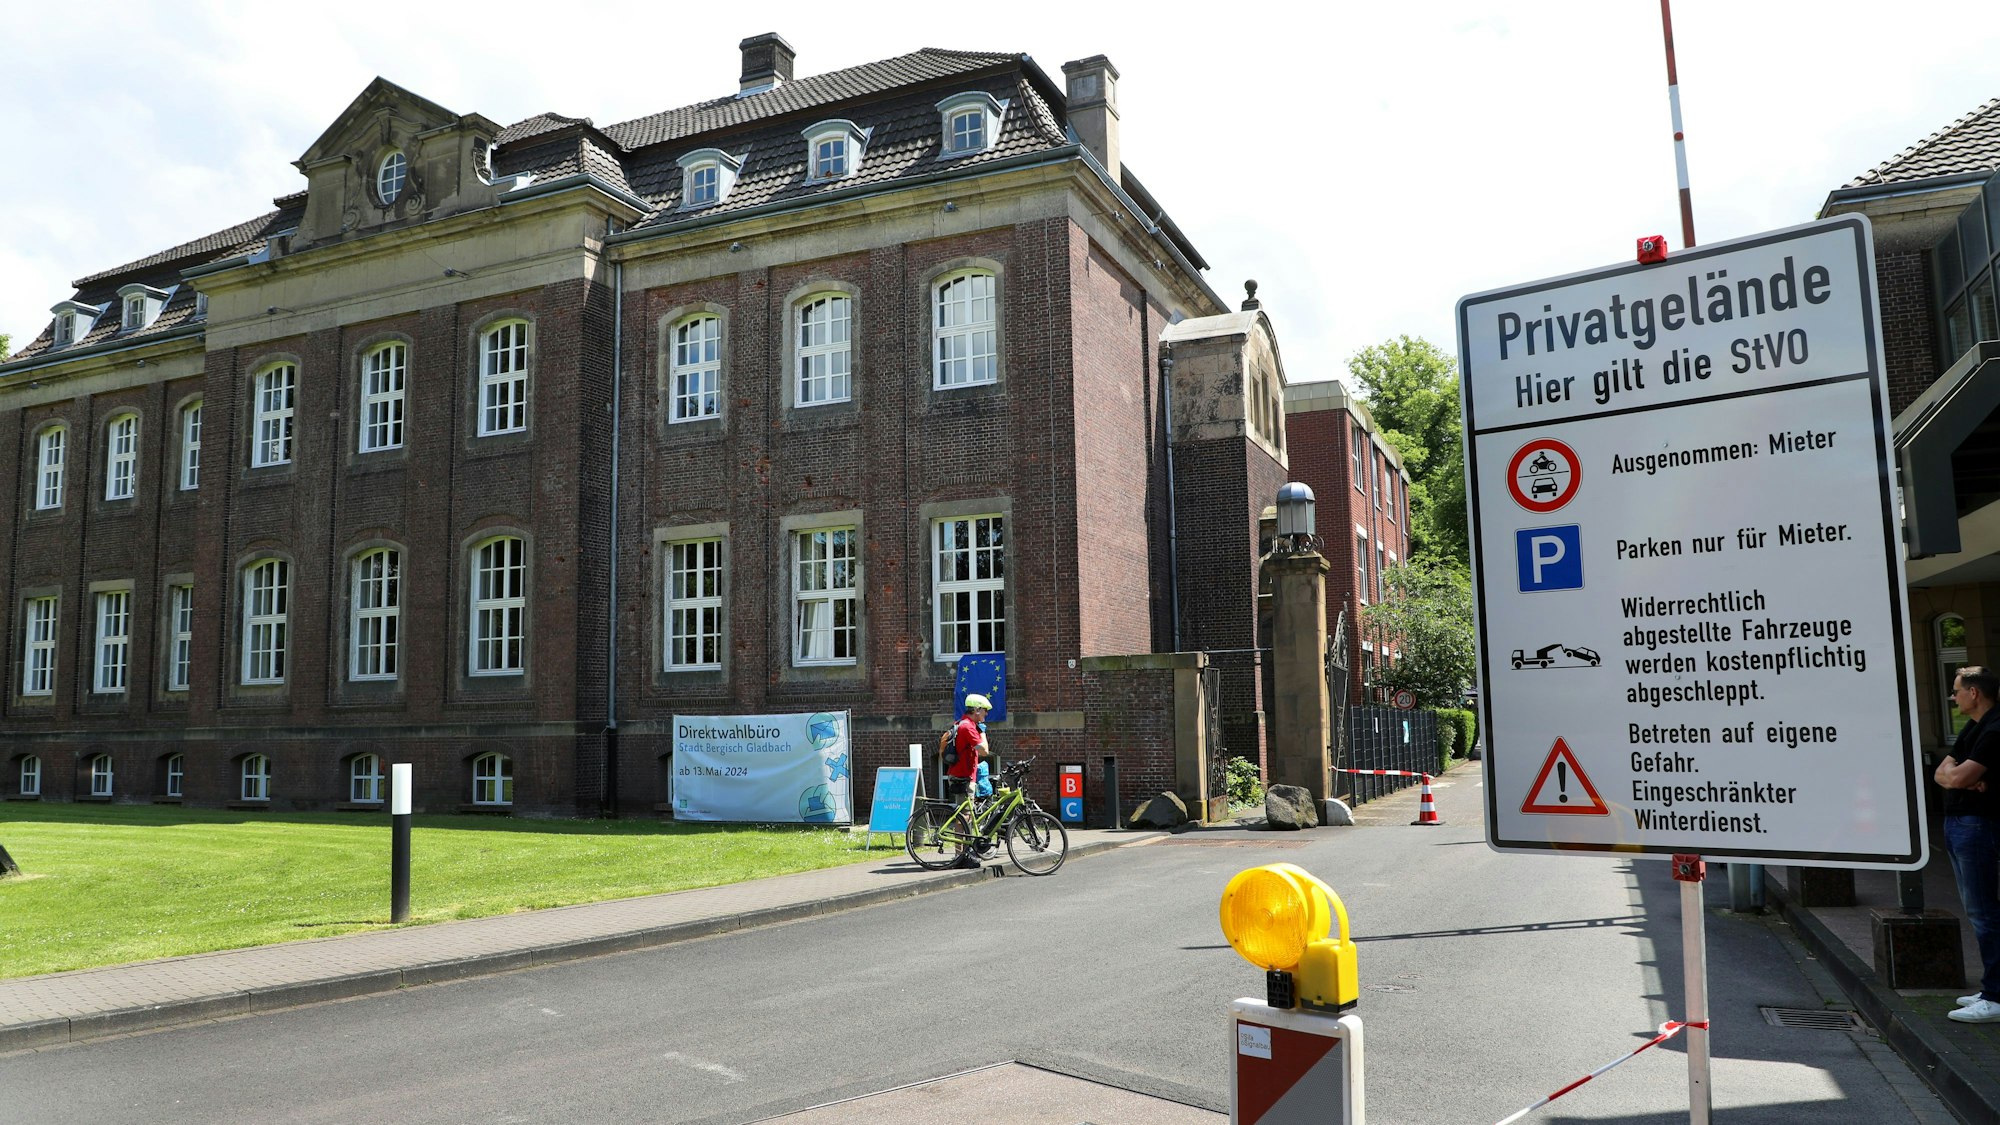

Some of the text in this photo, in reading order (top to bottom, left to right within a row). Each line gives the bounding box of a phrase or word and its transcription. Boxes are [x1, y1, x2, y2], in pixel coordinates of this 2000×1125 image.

[1498, 256, 1831, 361] Privatgelände
[1515, 328, 1809, 408] Hier gilt die StVO
[1612, 430, 1837, 475] Ausgenommen: Mieter
[1616, 522, 1852, 560] Parken nur für Mieter.
[1531, 535, 1566, 583] P
[1621, 589, 1766, 618] Widerrechtlich
[1623, 618, 1852, 650] abgestellte Fahrzeuge
[1625, 645, 1867, 675] werden kostenpflichtig
[1399, 694, 1410, 704] 20
[1627, 680, 1765, 708] abgeschleppt.
[679, 725, 780, 739] Direktwahlbüro
[1629, 721, 1838, 749] Betreten auf eigene
[679, 742, 791, 756] Stadt Bergisch Gladbach
[1631, 752, 1699, 773] Gefahr.
[679, 766, 690, 776] ab
[725, 767, 748, 776] 2024
[1066, 778, 1077, 793] B
[1632, 780, 1797, 807] Eingeschränkter
[1066, 802, 1078, 818] C
[1635, 808, 1768, 834] Winterdienst.
